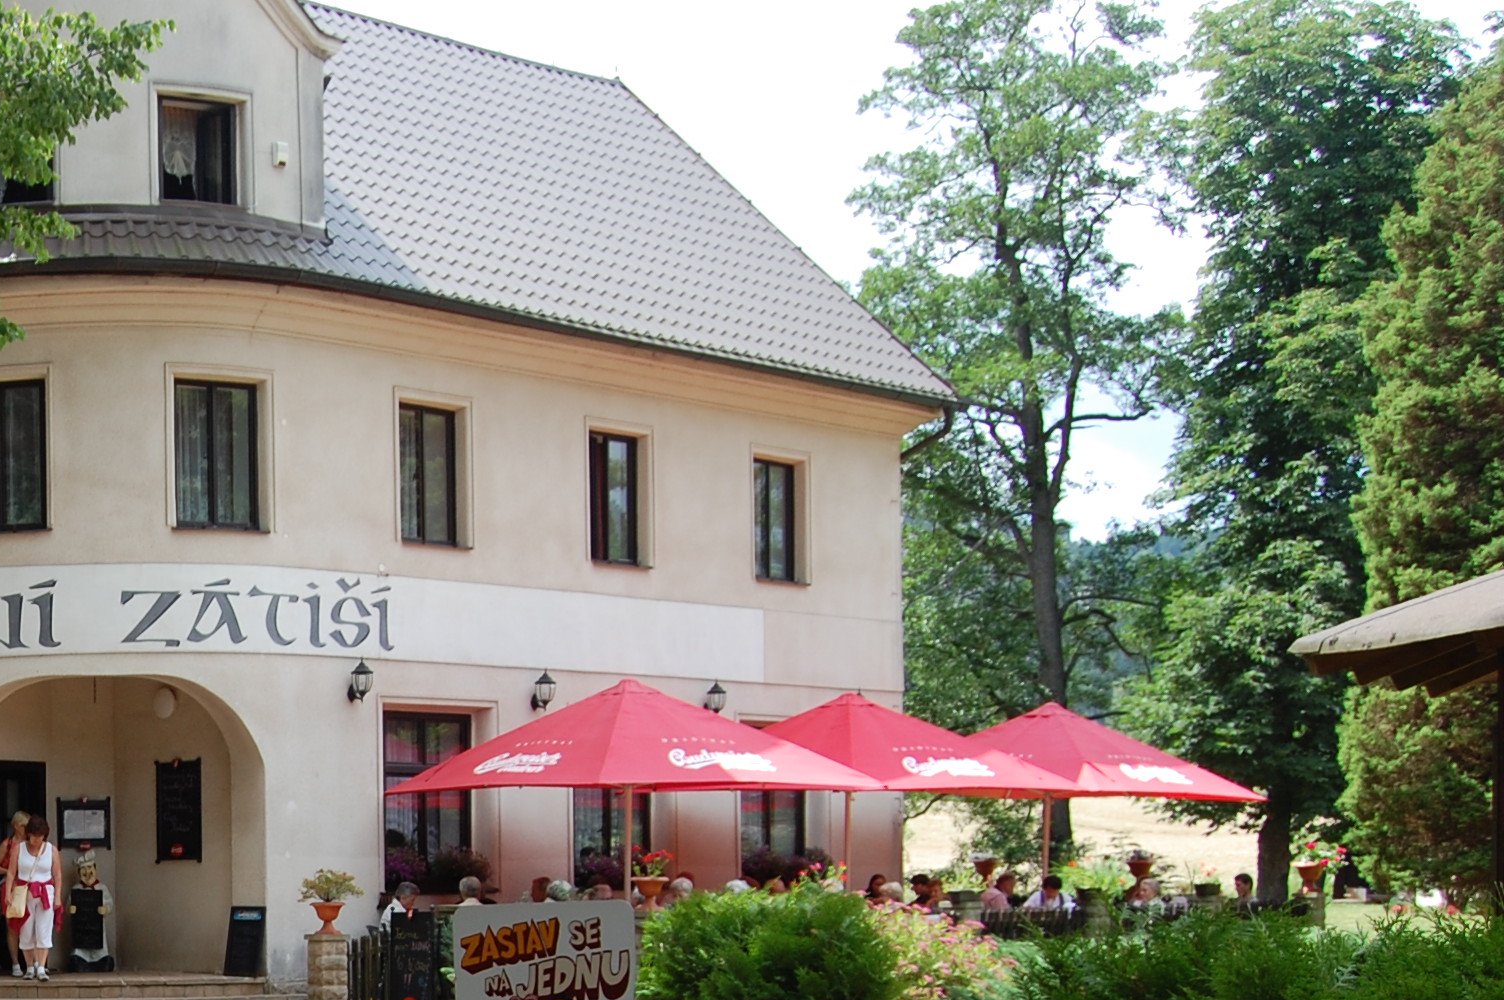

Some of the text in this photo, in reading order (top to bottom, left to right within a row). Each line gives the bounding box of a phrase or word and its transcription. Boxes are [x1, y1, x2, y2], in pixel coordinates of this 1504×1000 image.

[460, 917, 560, 974] ZASTAV
[569, 917, 601, 949] SE
[484, 970, 513, 998] NA
